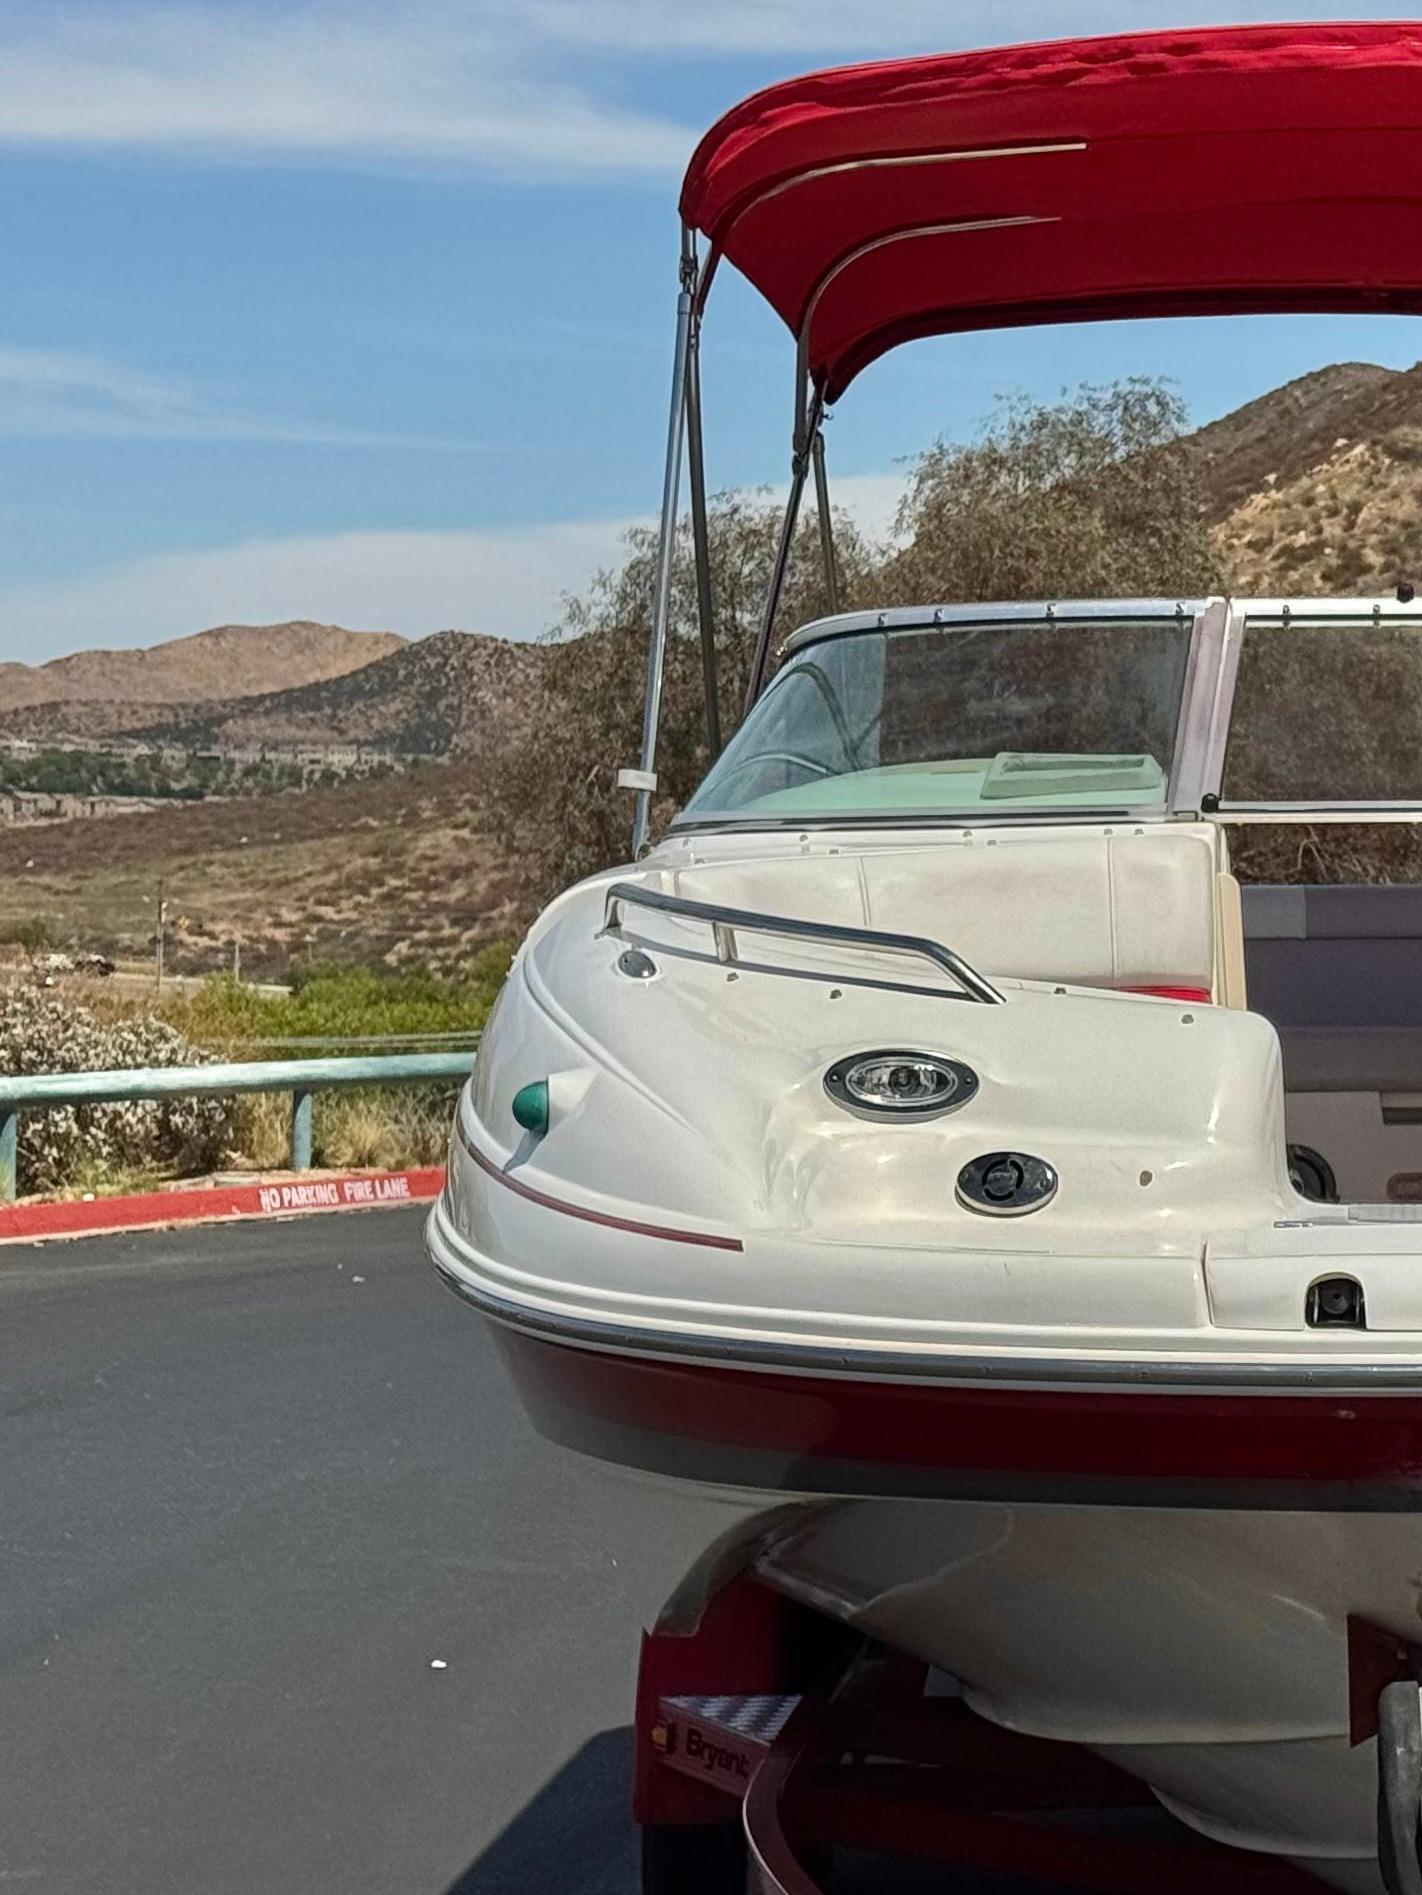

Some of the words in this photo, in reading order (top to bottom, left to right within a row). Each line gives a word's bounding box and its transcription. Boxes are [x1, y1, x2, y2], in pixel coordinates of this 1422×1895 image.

[259, 1188, 280, 1211] NO
[282, 1183, 339, 1207] PARKING
[344, 1180, 374, 1201] FIRE
[375, 1177, 410, 1198] LANE
[687, 1727, 749, 1779] Bryant
